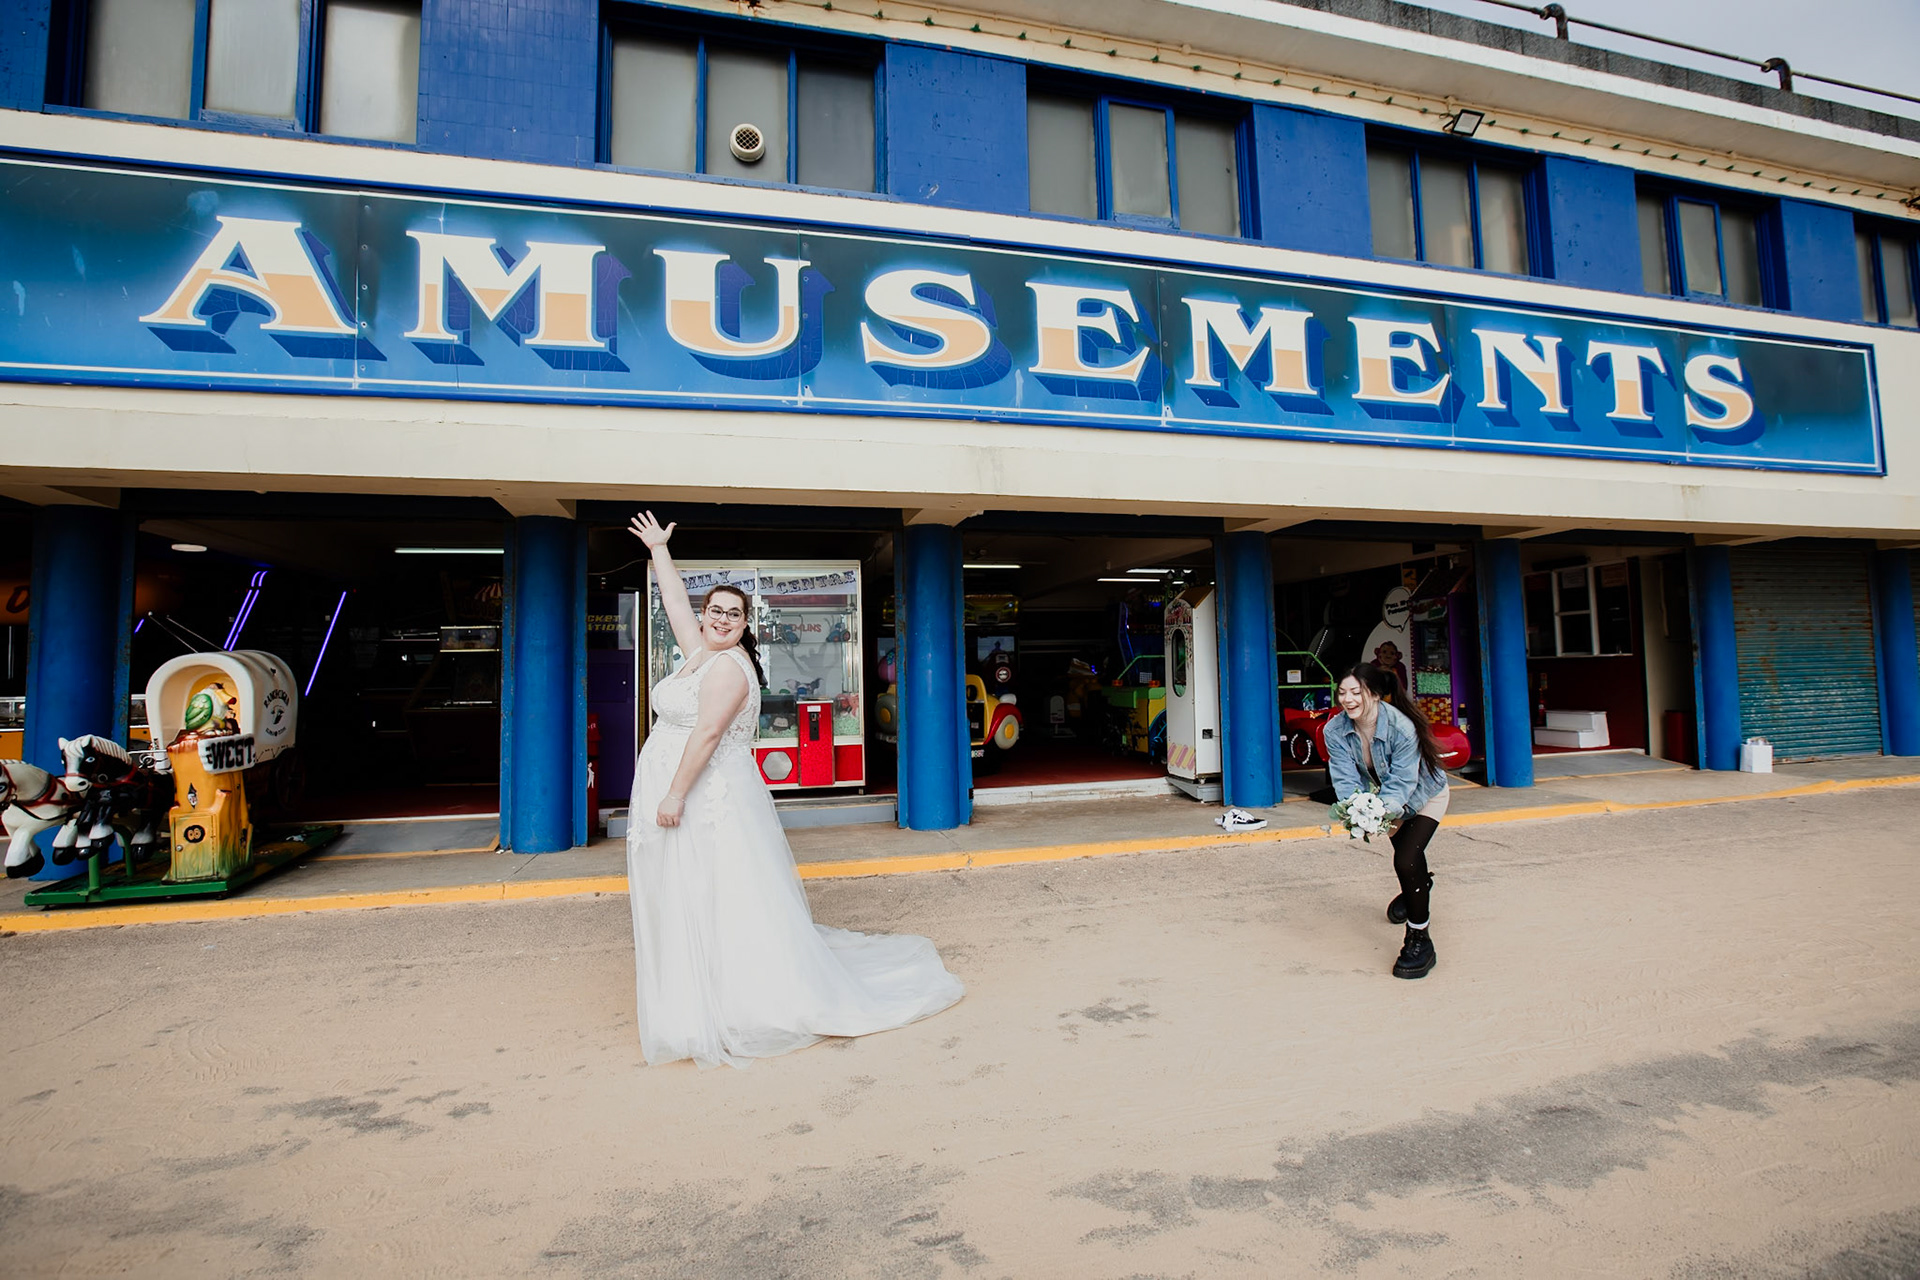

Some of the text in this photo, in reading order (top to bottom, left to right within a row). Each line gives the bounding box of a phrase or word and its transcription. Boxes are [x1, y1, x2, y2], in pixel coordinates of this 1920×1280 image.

[138, 215, 1756, 432] AMUSEMENTS
[651, 570, 731, 594] FMILY
[776, 570, 857, 595] CENTRE
[210, 737, 255, 769] WEST
